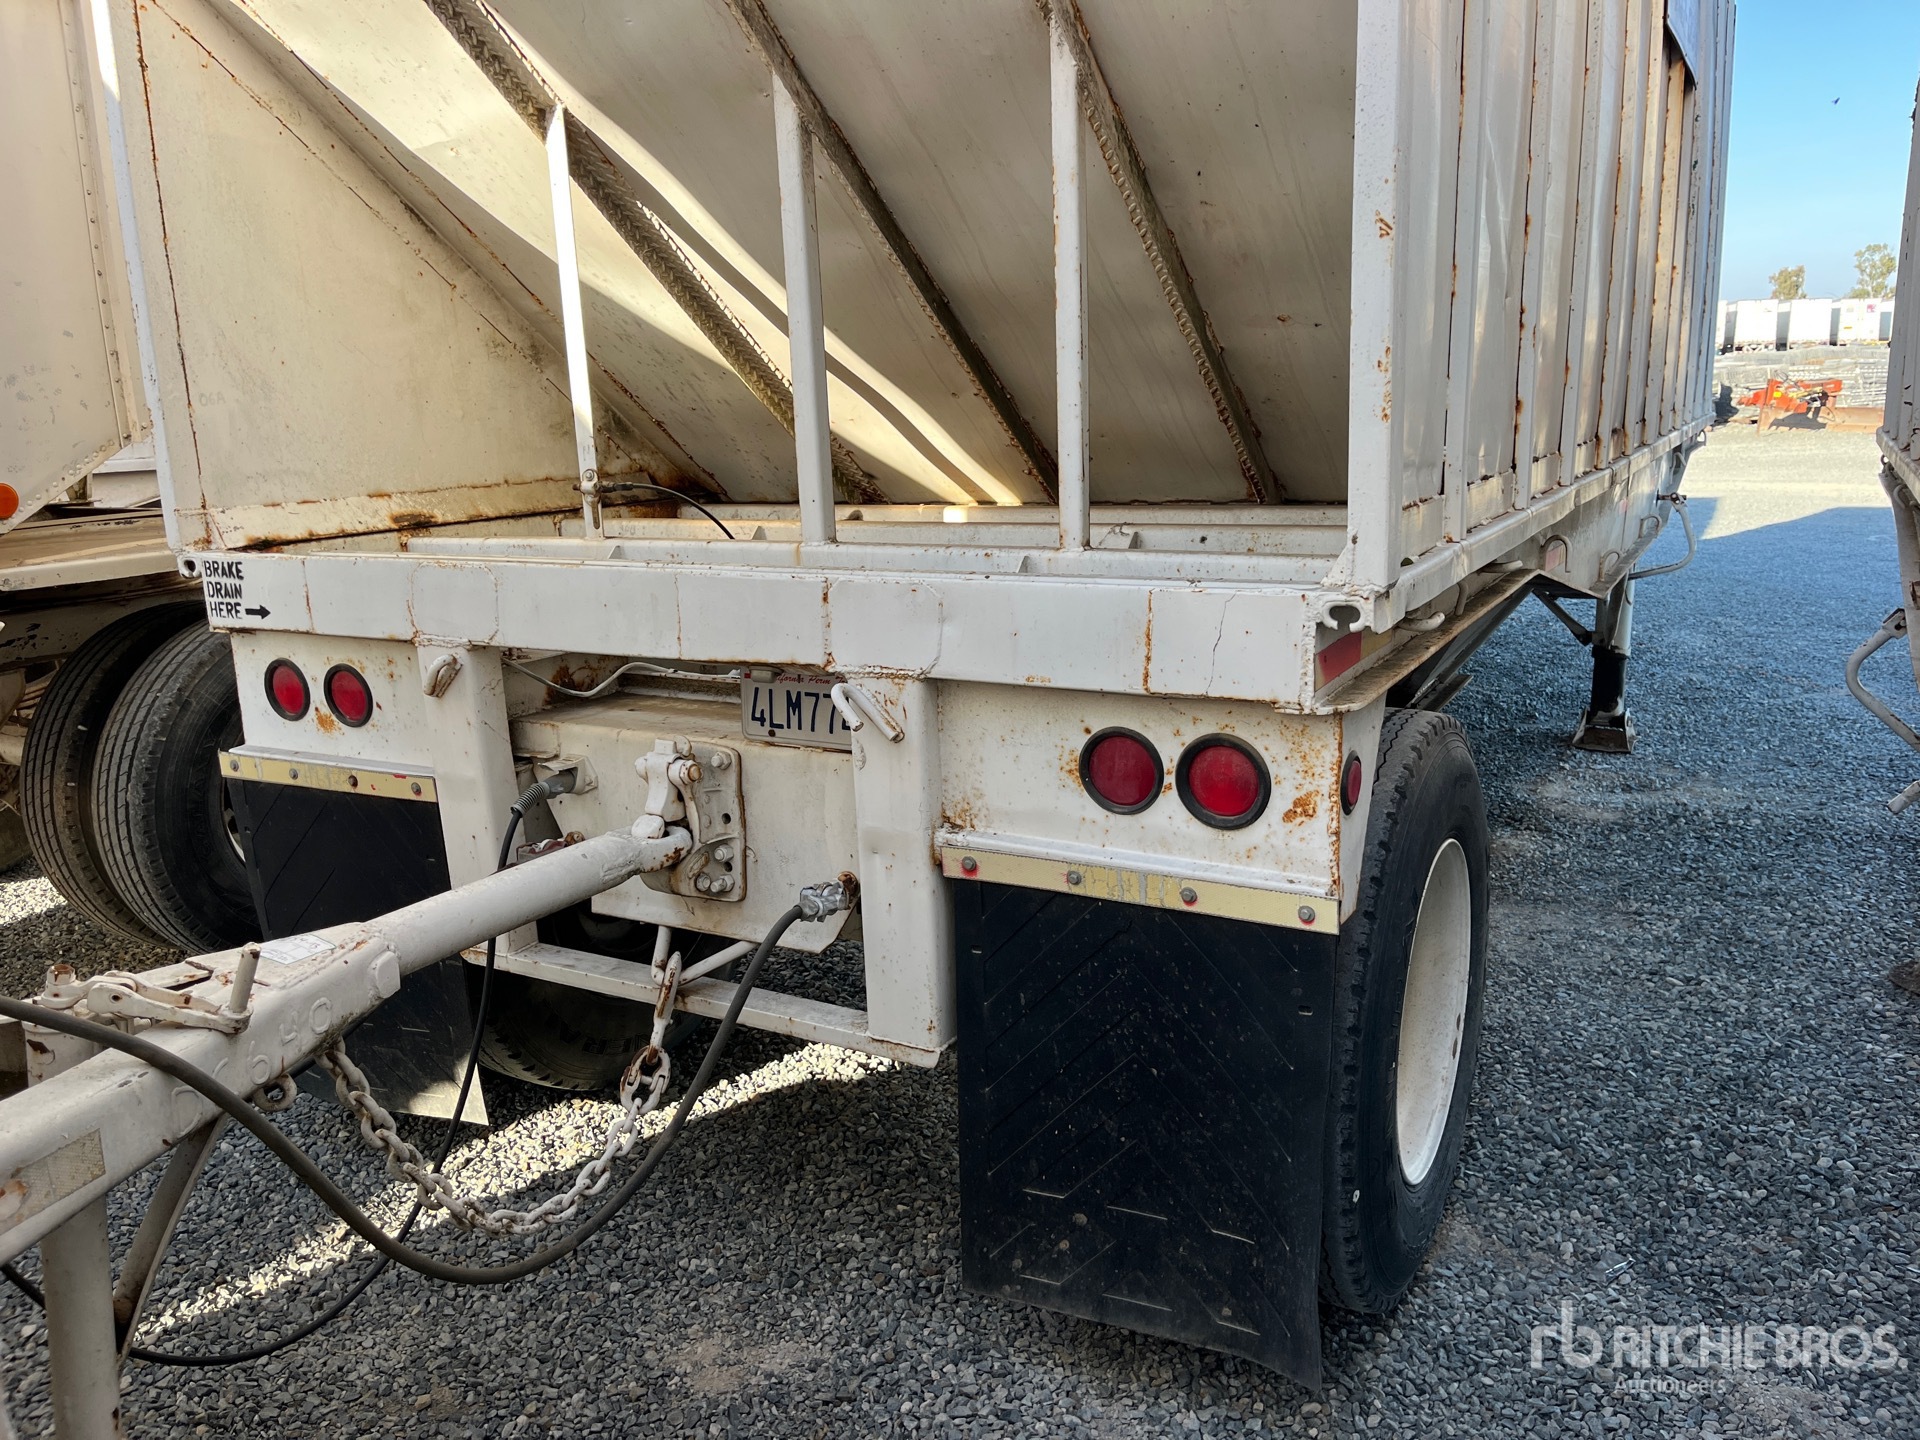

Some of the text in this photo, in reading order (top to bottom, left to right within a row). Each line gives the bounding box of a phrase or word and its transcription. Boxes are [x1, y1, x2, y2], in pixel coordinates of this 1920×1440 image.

[203, 560, 244, 580] BRAKE
[206, 581, 242, 599] DRAIN
[209, 601, 242, 619] HERE
